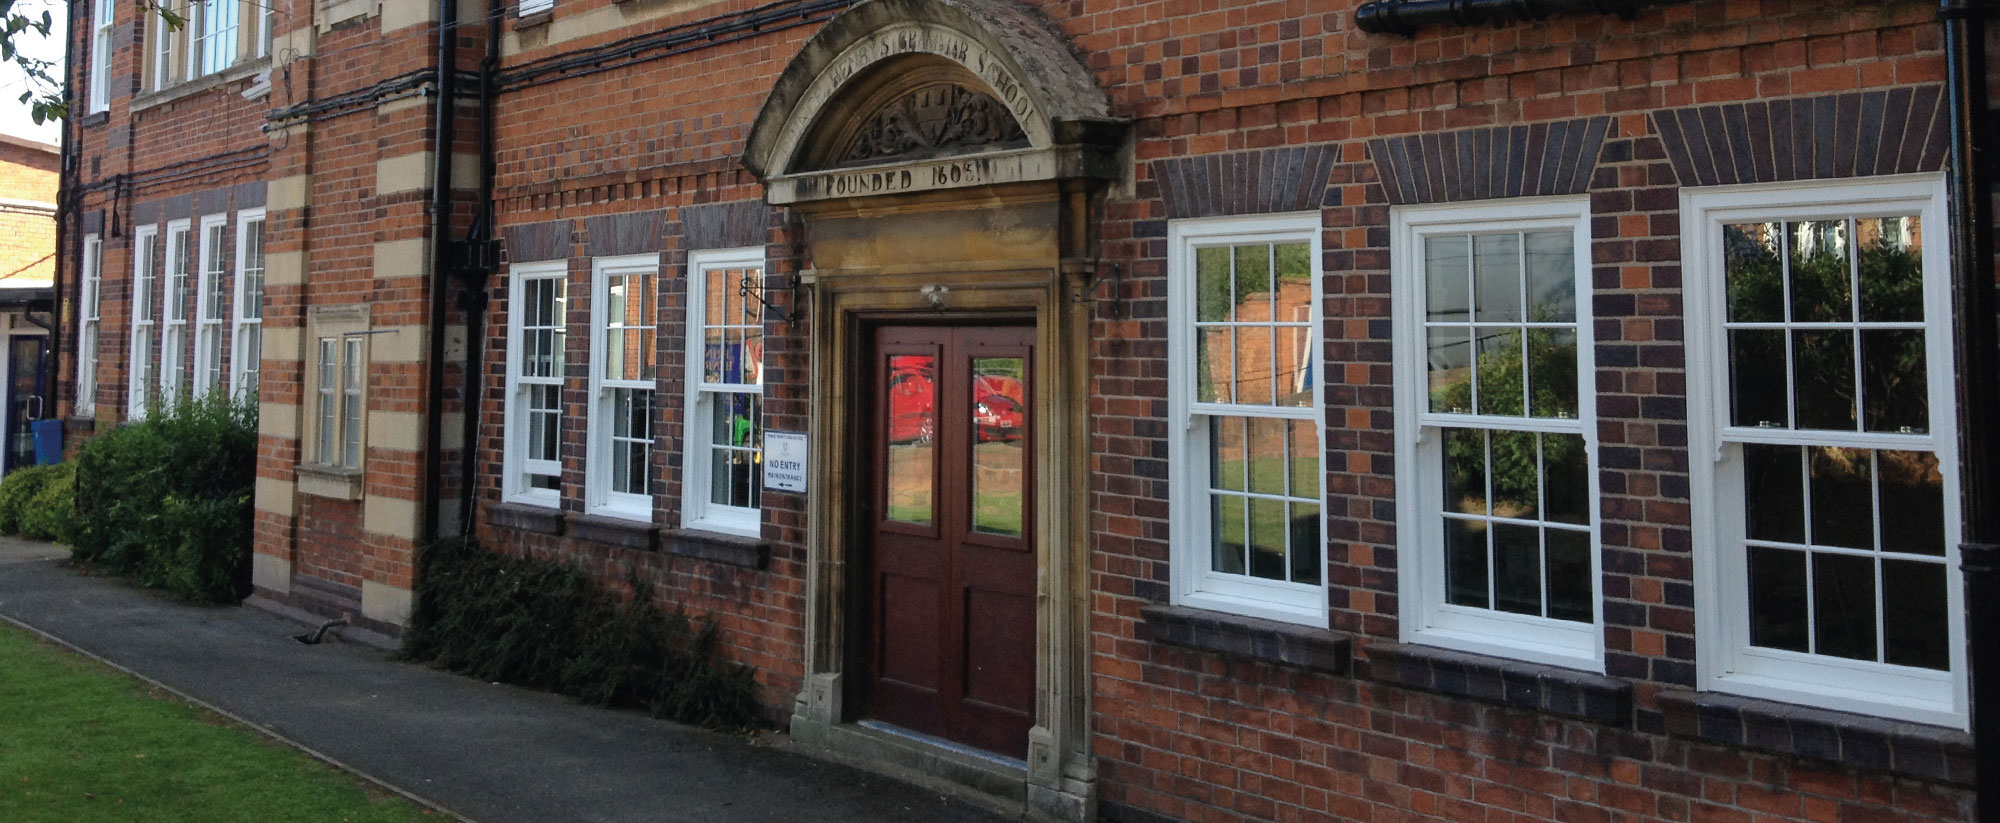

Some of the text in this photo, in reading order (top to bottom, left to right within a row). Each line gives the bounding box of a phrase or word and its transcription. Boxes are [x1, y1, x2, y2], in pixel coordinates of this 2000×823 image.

[978, 51, 1034, 131] SCHOOL
[826, 169, 912, 195] FOUNDED
[769, 459, 801, 471] NO ENTRY
[779, 473, 802, 482] ENTRANCE
